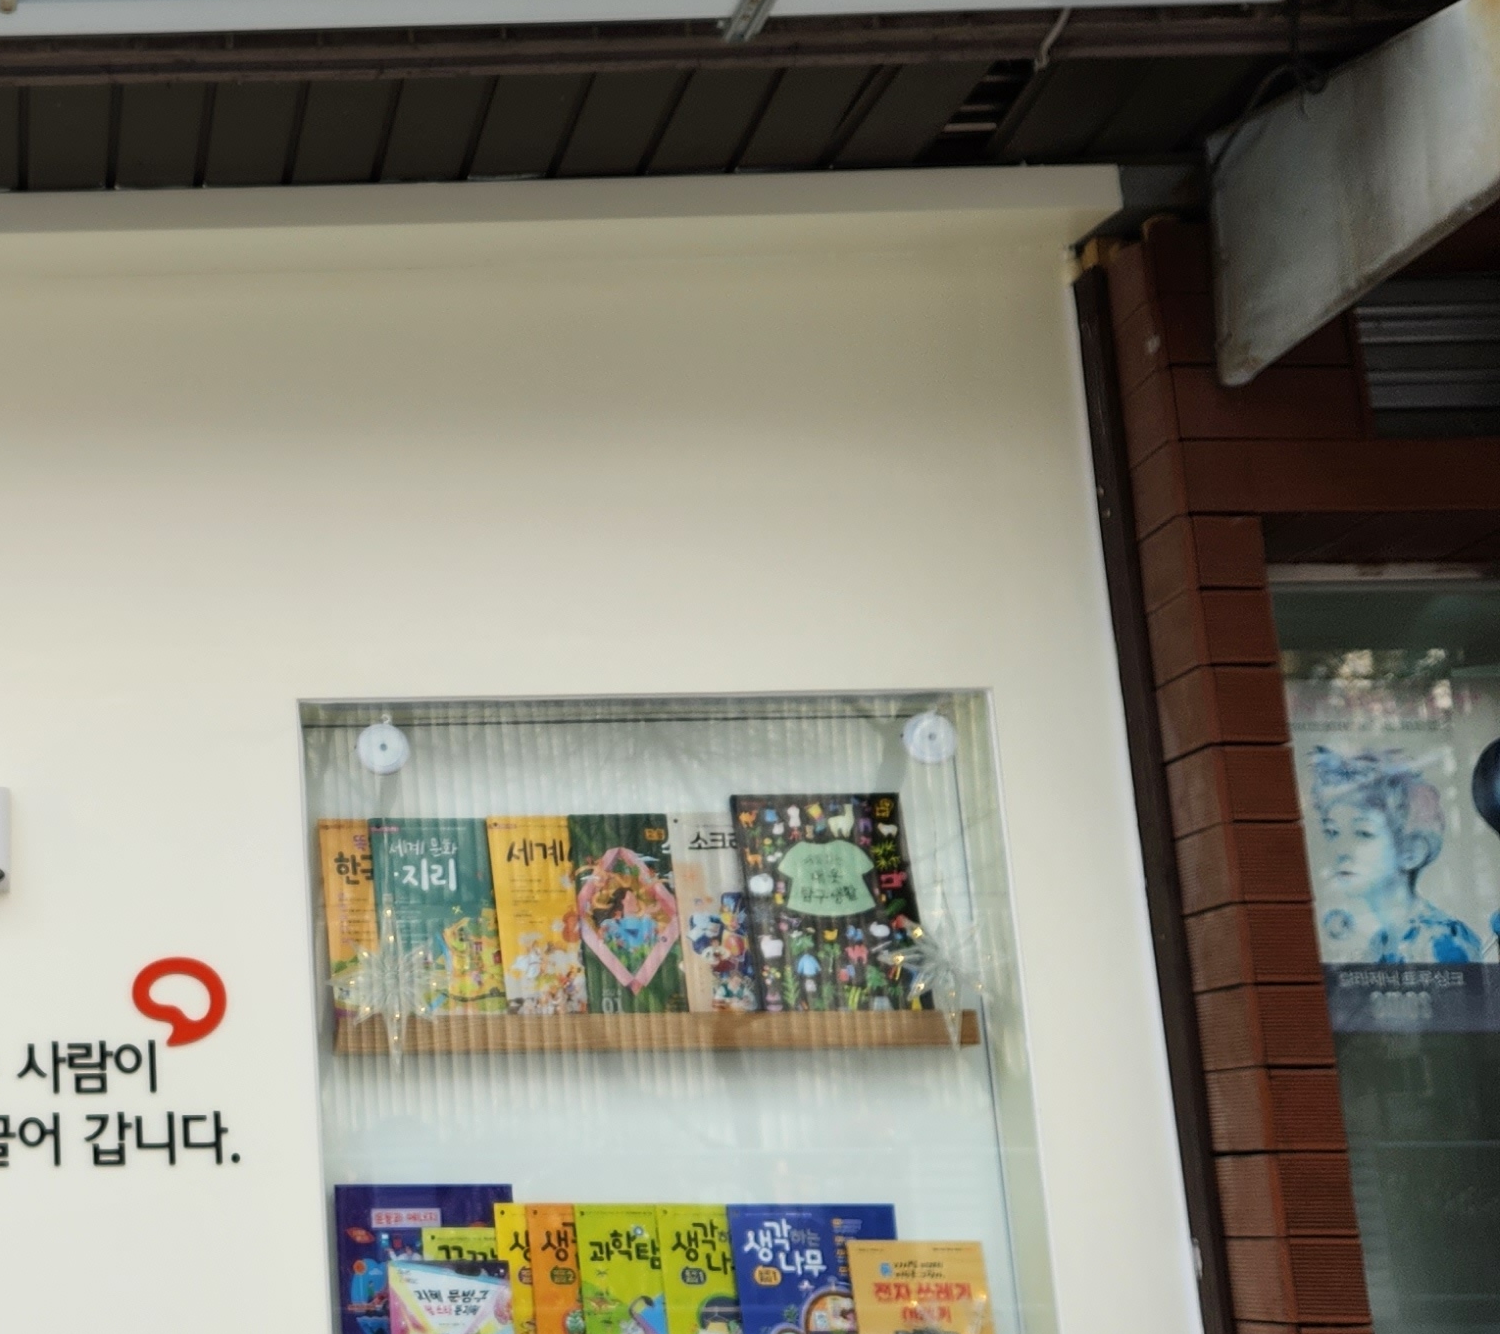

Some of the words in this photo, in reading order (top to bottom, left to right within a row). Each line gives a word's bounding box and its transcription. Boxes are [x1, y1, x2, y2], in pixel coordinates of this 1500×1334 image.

[389, 838, 425, 857] 세계
[506, 837, 573, 867] 세계
[16, 1039, 159, 1095] 사람이
[83, 1110, 242, 1167] 갑니다.
[671, 1219, 719, 1262] 생각
[743, 1218, 792, 1263] 생각
[779, 1248, 827, 1277] 나무
